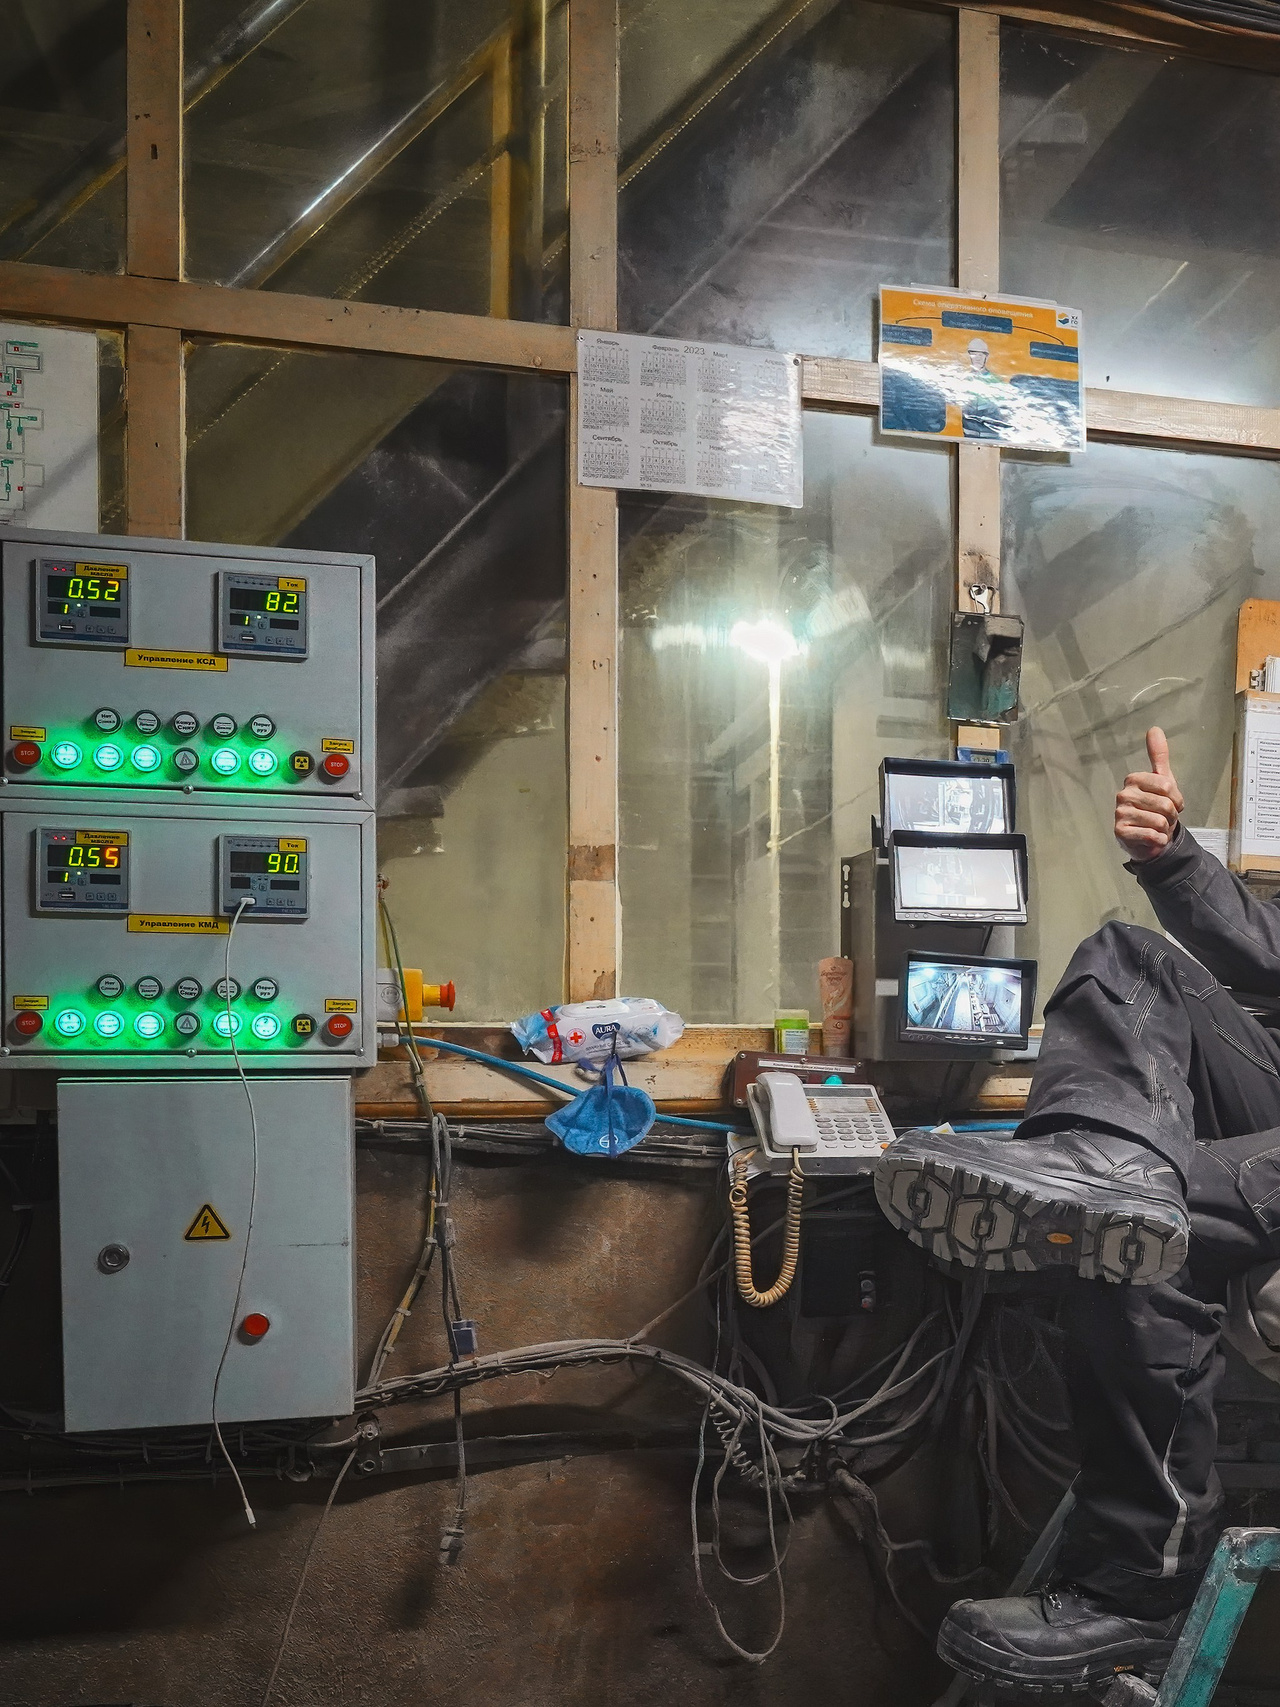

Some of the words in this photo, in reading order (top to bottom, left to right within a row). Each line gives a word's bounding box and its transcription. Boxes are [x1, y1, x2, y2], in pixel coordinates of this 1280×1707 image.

[913, 298, 936, 308] Схема
[937, 302, 987, 314] оперативного
[684, 345, 706, 356] 2023
[592, 434, 622, 443] Сентябрь
[652, 439, 678, 447] Октябрь
[68, 578, 119, 601] 0.52
[64, 604, 69, 614] 1
[245, 616, 249, 625] 1
[137, 654, 194, 664] Управление
[196, 658, 216, 666] КСД
[68, 846, 119, 868] 0.55
[64, 872, 69, 882] 1
[140, 920, 195, 928] Управление
[198, 921, 219, 929] КМД
[595, 1025, 617, 1034] AURA
